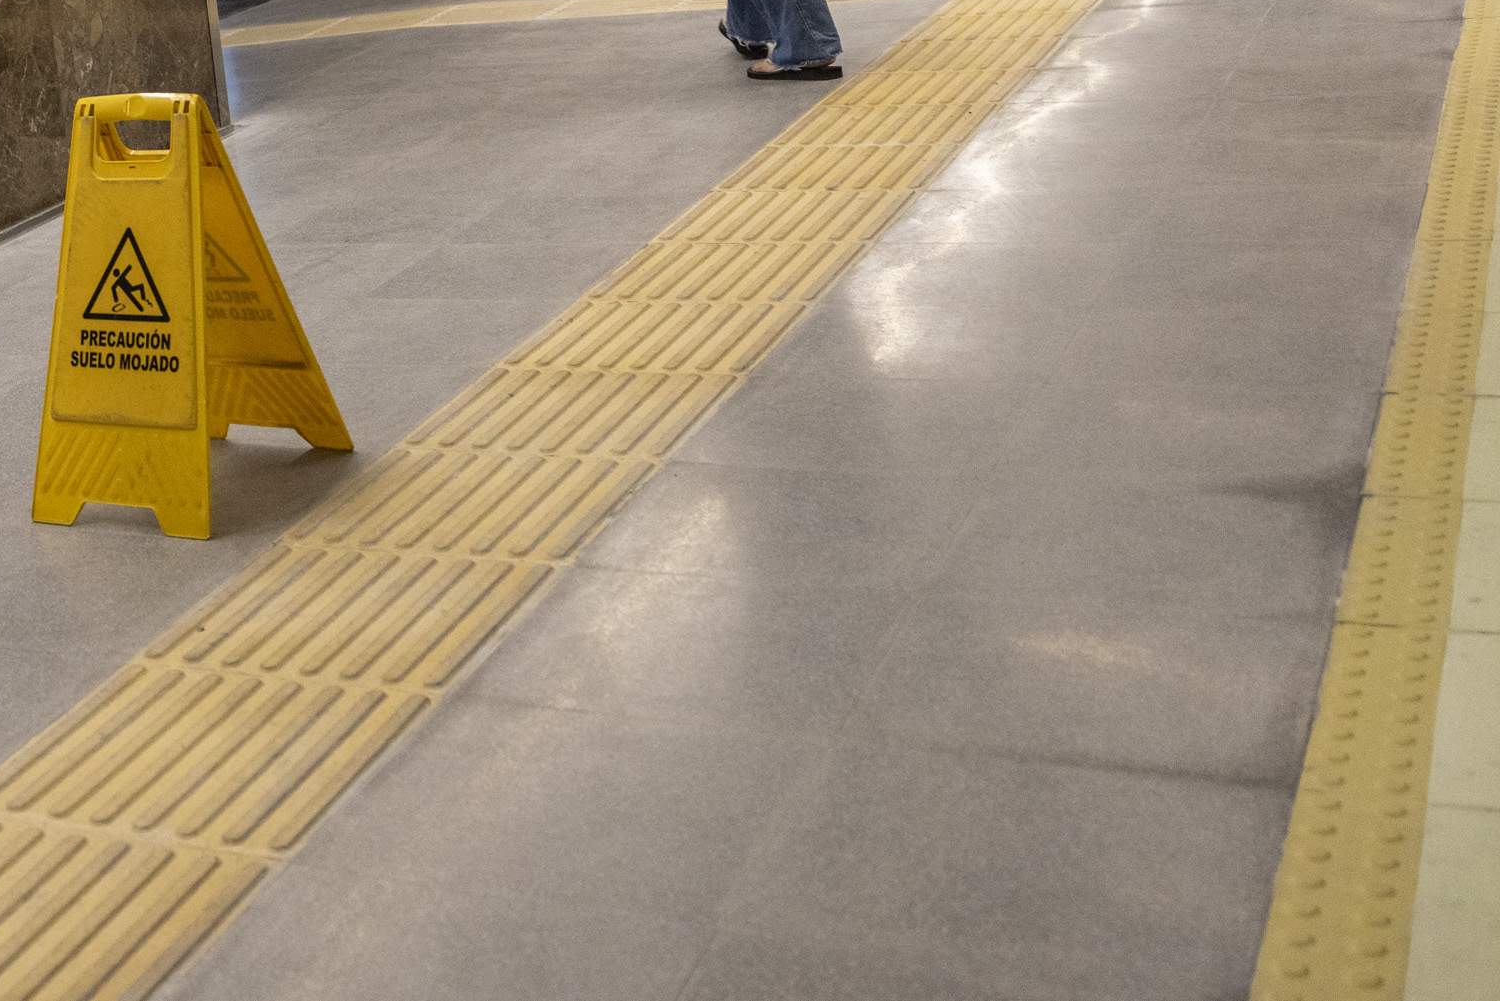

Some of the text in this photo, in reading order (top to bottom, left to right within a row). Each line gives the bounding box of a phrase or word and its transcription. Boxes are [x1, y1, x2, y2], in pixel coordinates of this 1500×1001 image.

[80, 329, 171, 350] PRECAUCIÓN
[70, 351, 180, 373] SUELO MOJADO
